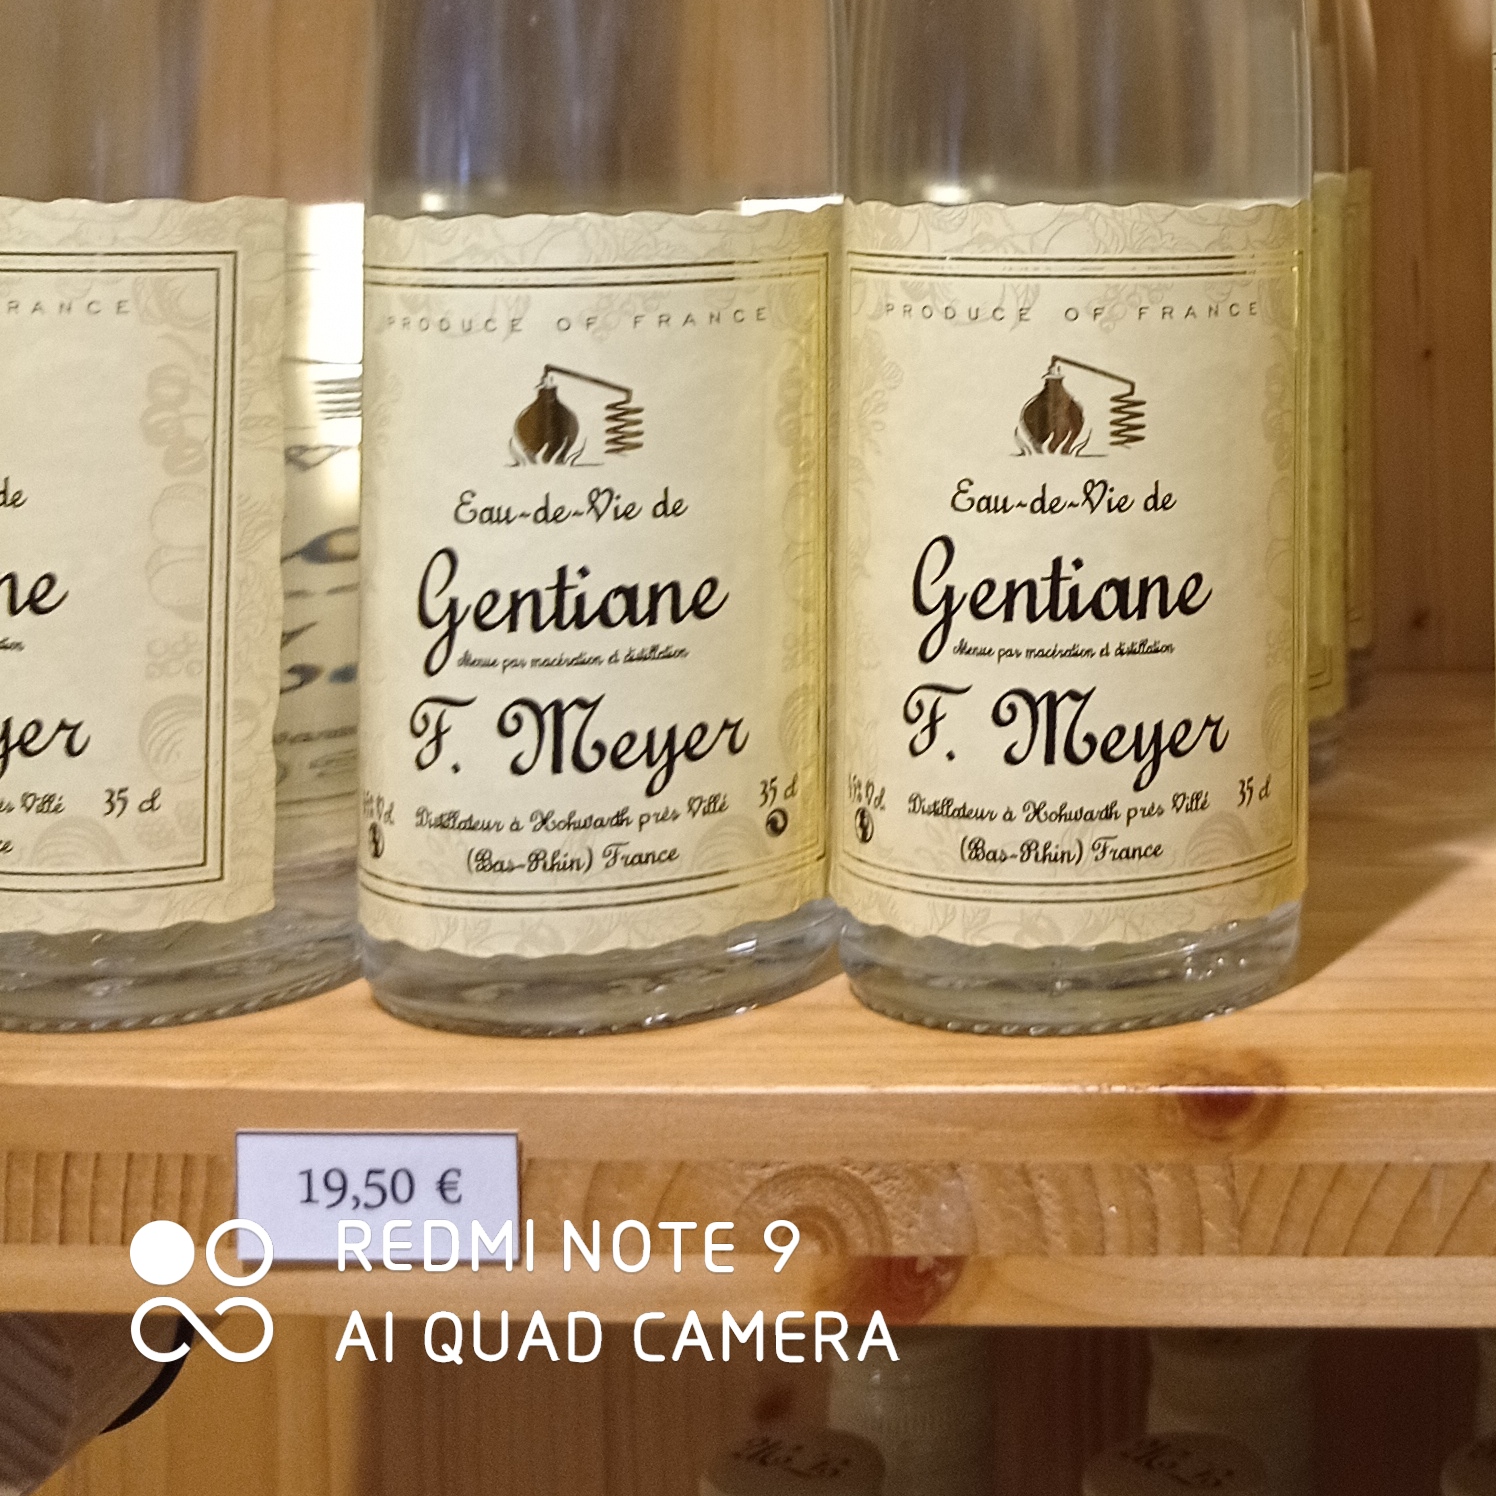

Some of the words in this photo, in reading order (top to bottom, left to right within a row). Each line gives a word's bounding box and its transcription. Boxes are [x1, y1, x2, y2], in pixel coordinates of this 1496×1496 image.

[7, 298, 132, 316] RANCE
[387, 315, 523, 333] PRODUCE
[556, 315, 599, 333] OF
[633, 305, 770, 329] FRANCE
[884, 303, 1033, 323] PRODUCE
[1063, 305, 1104, 323] OF
[1137, 300, 1260, 321] FRANCE
[652, 486, 689, 518] de
[1143, 479, 1177, 514] de
[418, 546, 730, 677] Gentiane
[911, 534, 1213, 665] Gentiane
[997, 646, 1022, 664] par
[409, 695, 478, 774] F.
[497, 693, 751, 798] Meyer
[902, 682, 973, 761] F.
[991, 685, 1230, 793] Meyer
[103, 786, 129, 819] 35
[137, 786, 162, 814] cl
[415, 805, 503, 832] Distillateur
[509, 815, 524, 831] à
[759, 778, 778, 808] 35
[907, 791, 998, 822] Distillateur
[1002, 805, 1016, 822] à
[1022, 799, 1122, 823] Hohwarth
[1126, 798, 1164, 826] près
[1237, 775, 1255, 808] 35
[600, 840, 680, 870] France
[1091, 834, 1165, 862] France
[297, 1165, 416, 1211] 19,50
[434, 1166, 464, 1207] €
